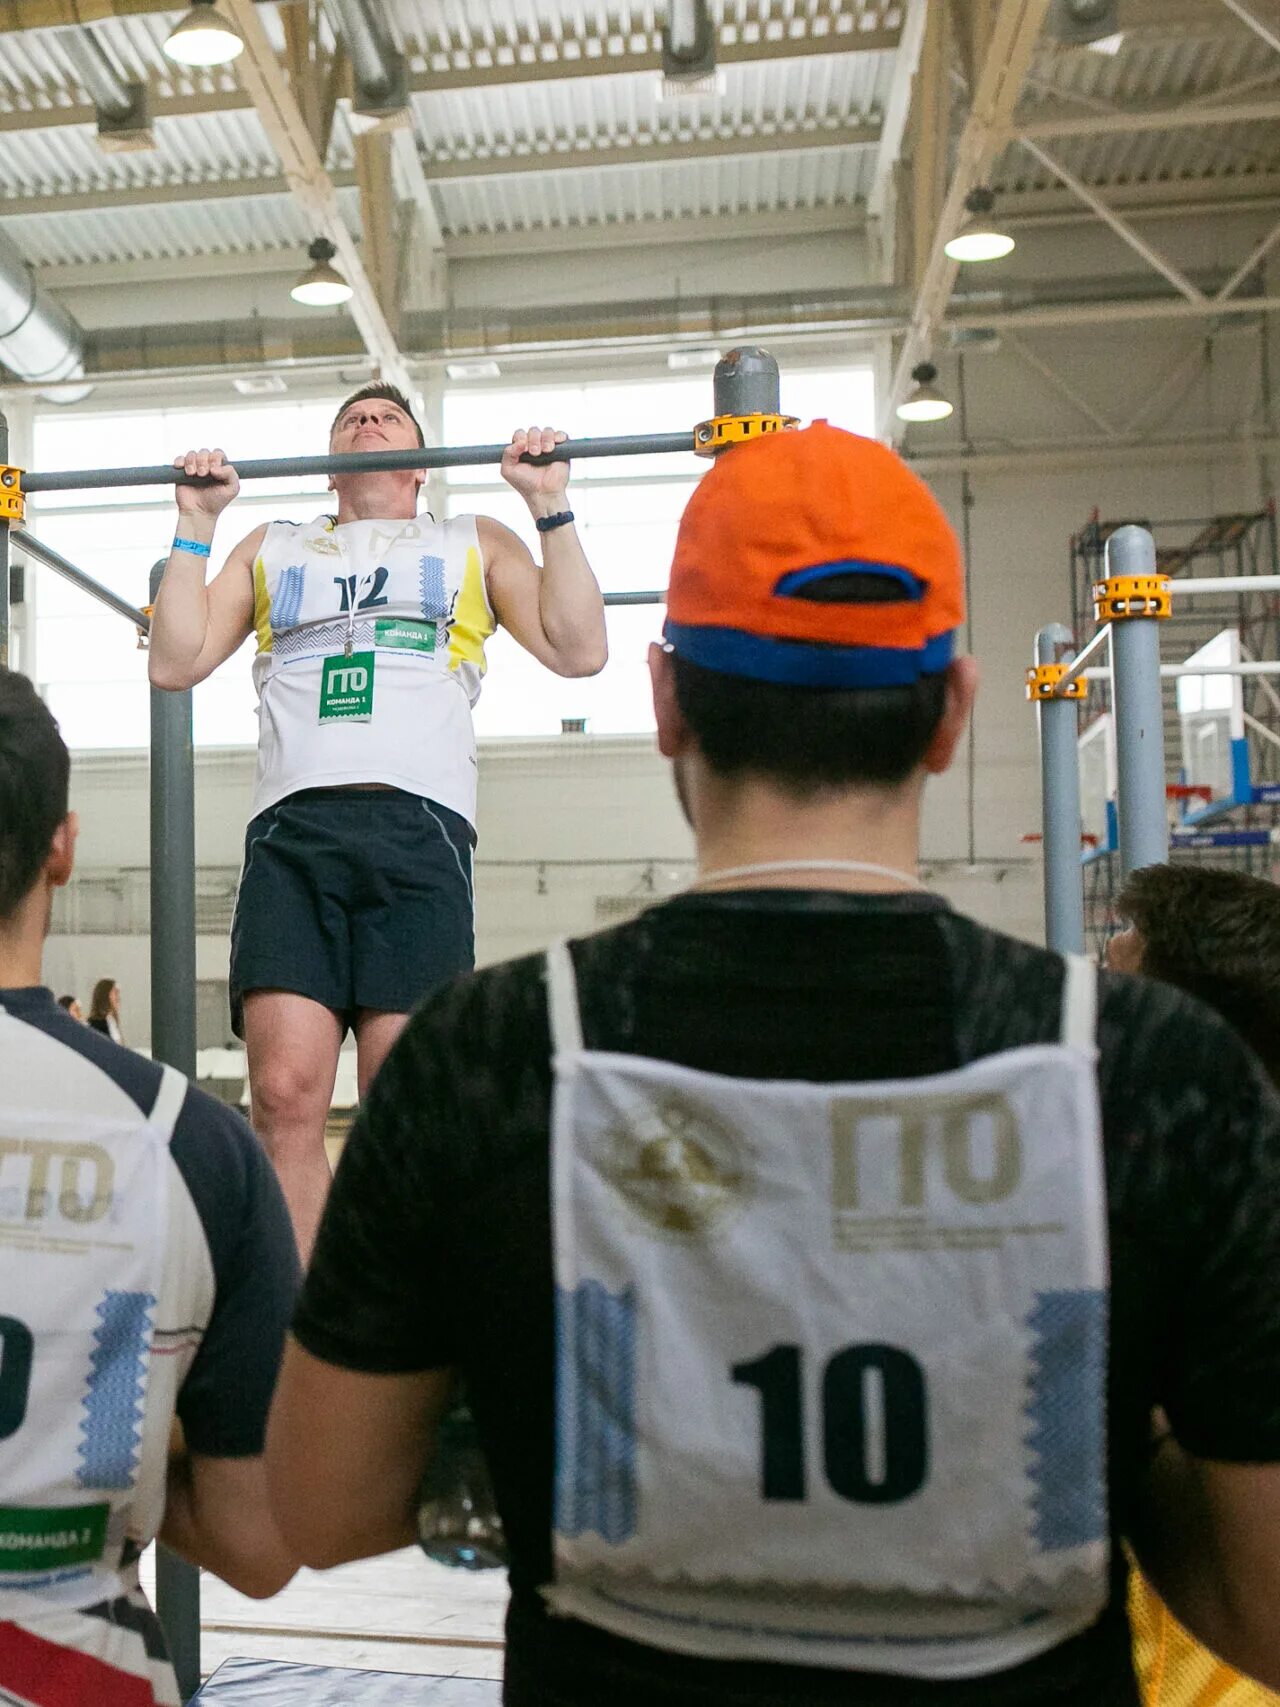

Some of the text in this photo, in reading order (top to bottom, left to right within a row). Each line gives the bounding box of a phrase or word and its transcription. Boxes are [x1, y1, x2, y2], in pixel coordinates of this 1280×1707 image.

[333, 566, 389, 612] 12
[384, 629, 423, 641] КОМАНДА
[327, 667, 368, 695] ГТО
[326, 697, 361, 706] КОМАНДА
[828, 1092, 1024, 1210] ГТО
[731, 1342, 929, 1507] 10
